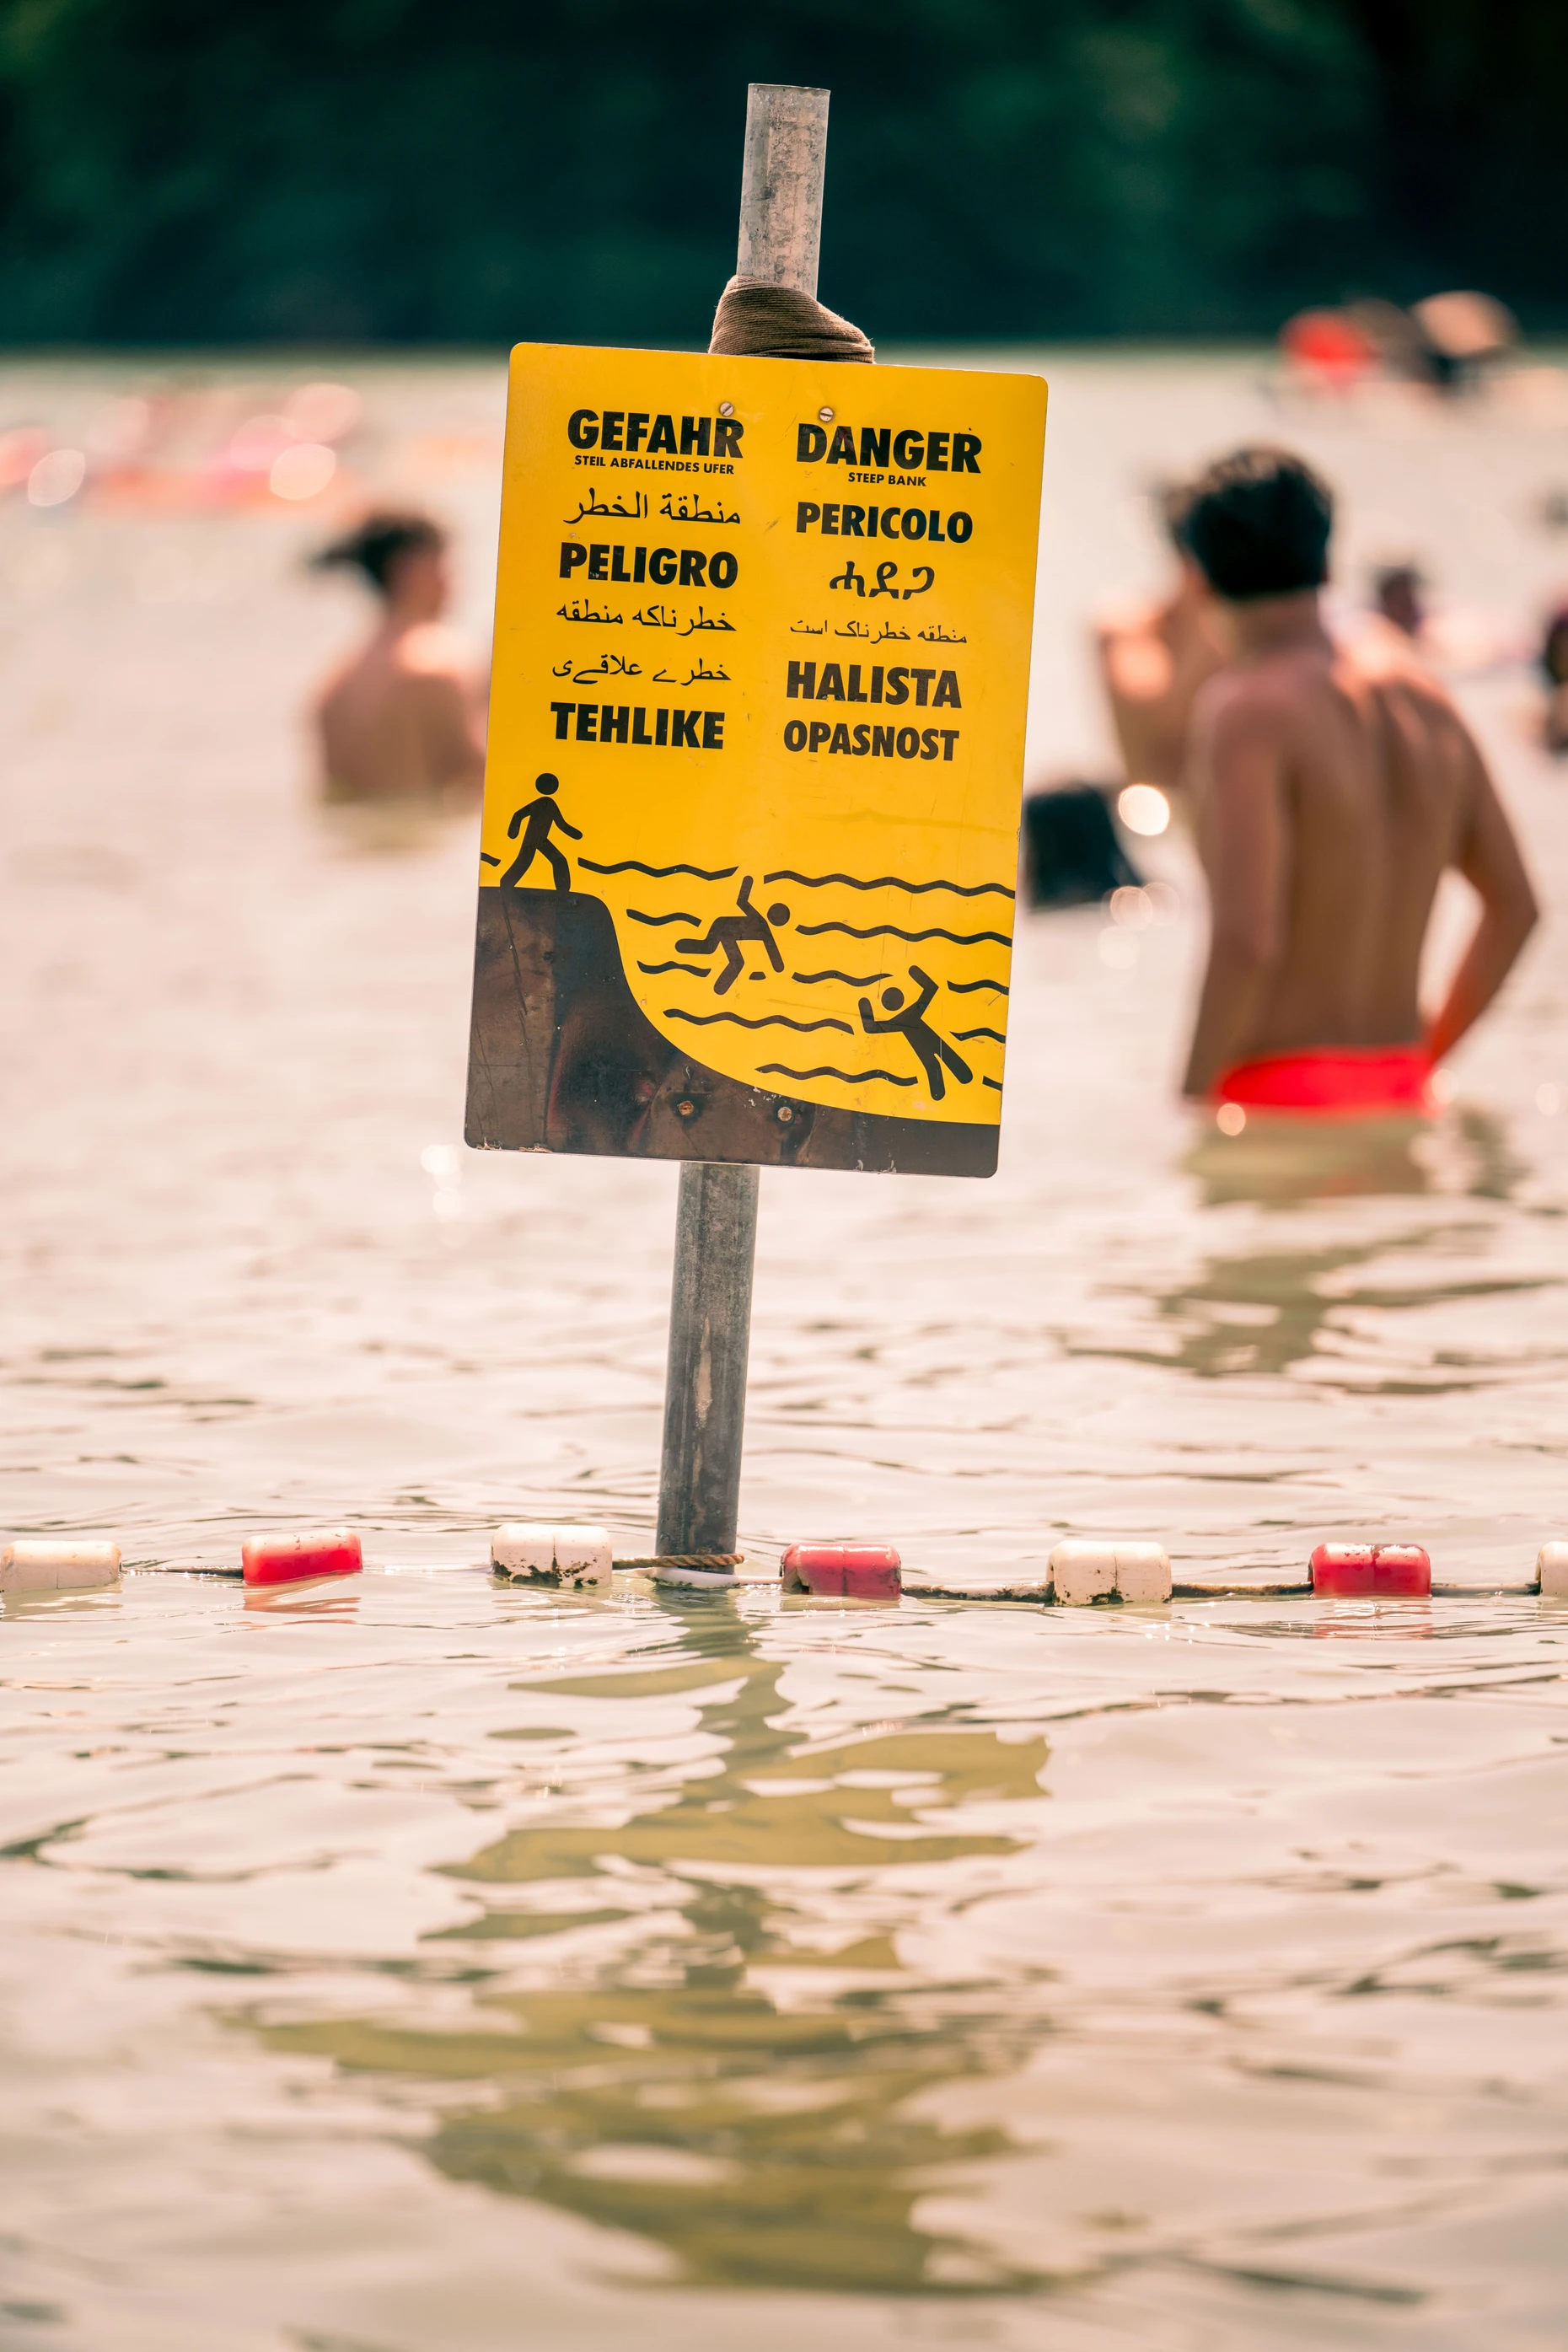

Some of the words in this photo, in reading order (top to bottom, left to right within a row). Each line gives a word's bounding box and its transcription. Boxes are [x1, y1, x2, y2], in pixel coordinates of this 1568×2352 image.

[568, 409, 744, 459] GEFAHR
[797, 422, 982, 473] DANGER
[574, 455, 605, 467] STEIL
[610, 458, 699, 473] ABFALLENDES
[704, 463, 734, 475] UFER
[847, 472, 884, 484] STEEP
[889, 475, 927, 487] BANK
[563, 487, 648, 524] الخطر
[659, 493, 741, 524] منطقة
[797, 502, 974, 544] PERICOLO
[559, 542, 738, 589] PELIGRO
[556, 599, 624, 626] منطقه
[790, 620, 828, 636] است
[787, 661, 962, 709] HALISTA
[550, 702, 726, 749] TEHLIKE
[784, 720, 960, 761] OPASNOST
